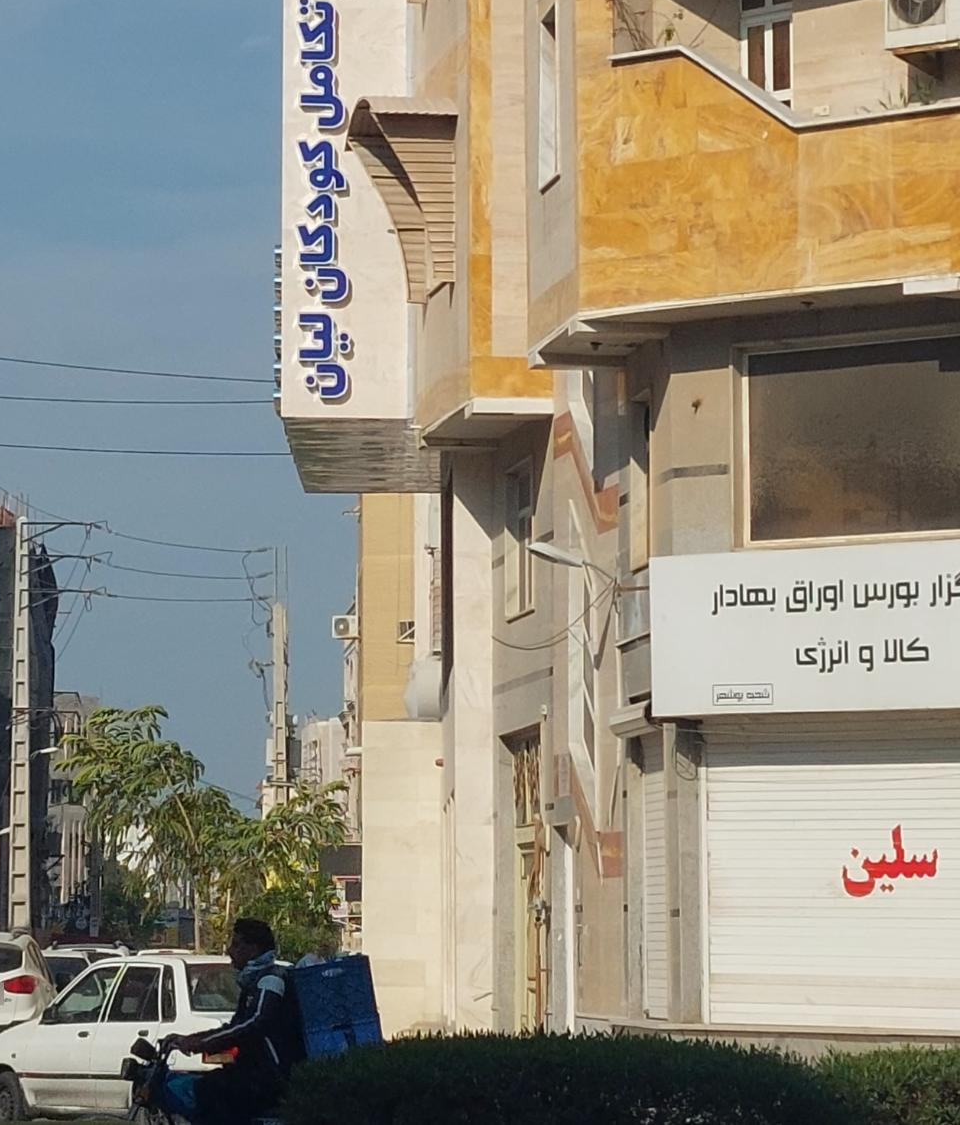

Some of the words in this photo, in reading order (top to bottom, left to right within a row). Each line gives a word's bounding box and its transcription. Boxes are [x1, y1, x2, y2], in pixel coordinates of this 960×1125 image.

[299, 140, 346, 303] کودکان
[299, 313, 350, 398] لیان
[712, 583, 776, 615] بهادار
[786, 579, 843, 613] اوراق
[853, 581, 919, 609] بورس
[796, 637, 848, 673] انرژی
[859, 645, 874, 671] و
[883, 637, 930, 662] کالا
[716, 688, 744, 703] بوشهر
